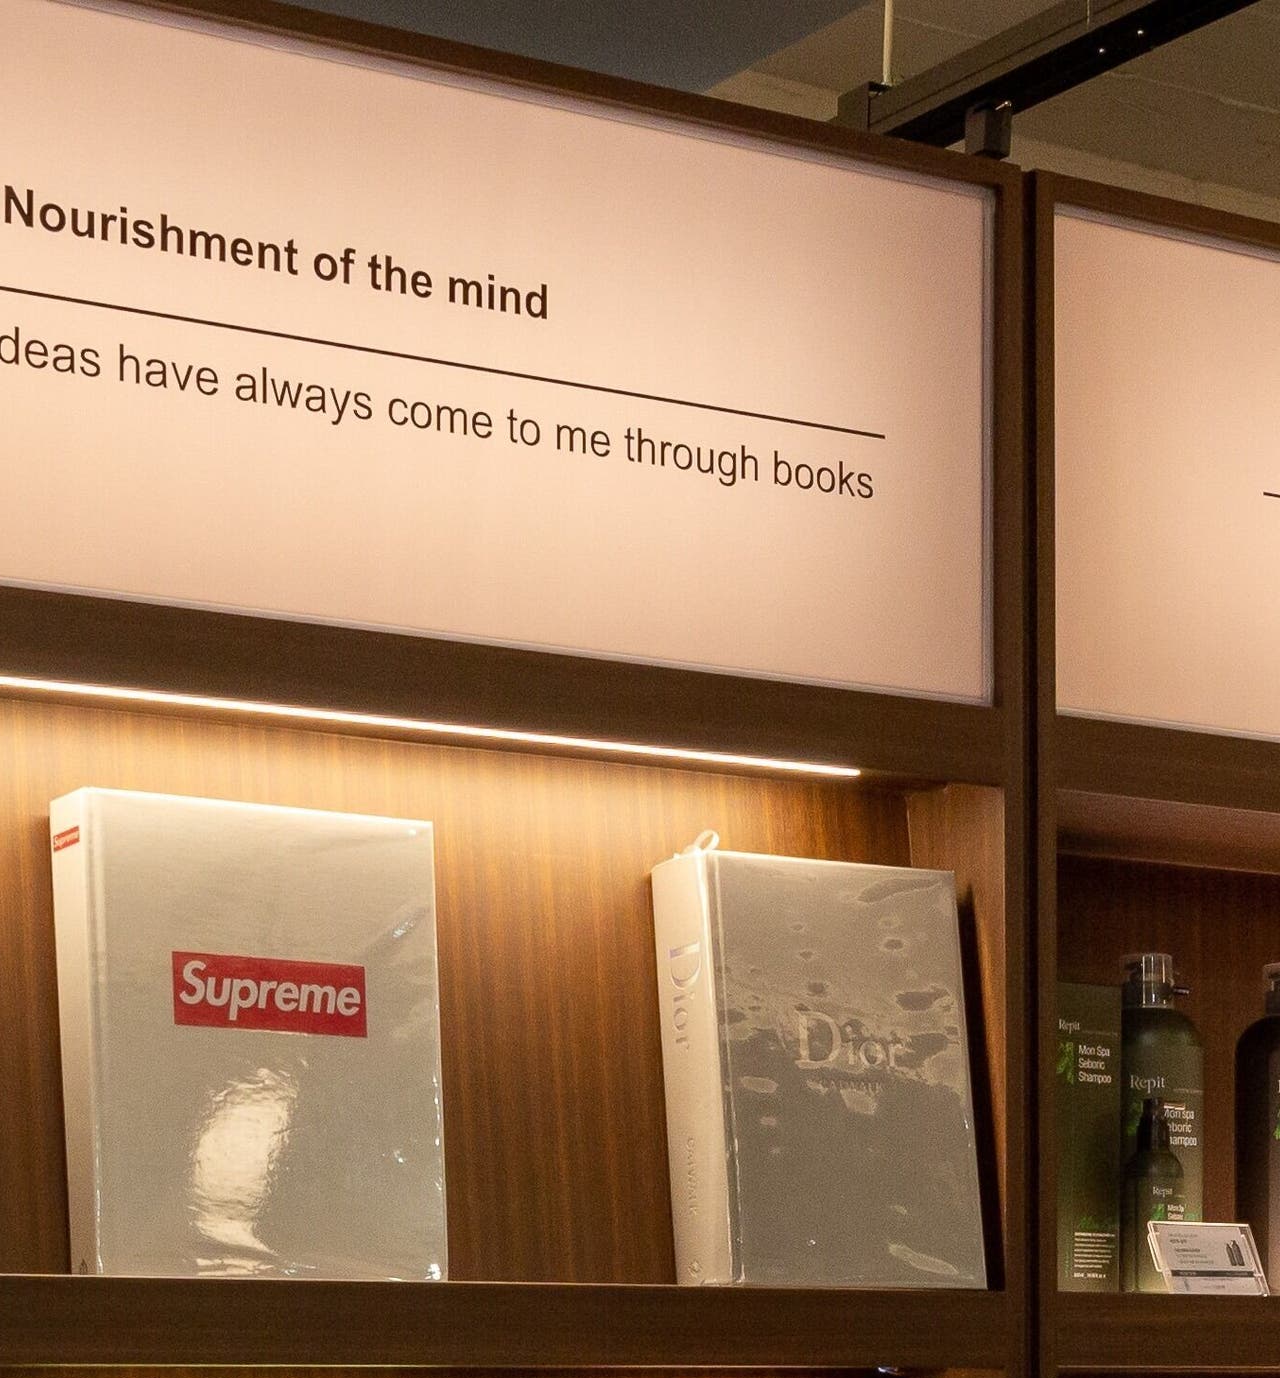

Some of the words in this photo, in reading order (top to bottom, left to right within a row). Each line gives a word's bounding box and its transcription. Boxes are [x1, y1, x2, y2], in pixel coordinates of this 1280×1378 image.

[4, 185, 297, 276] Nourishment
[313, 247, 355, 286] of
[369, 255, 433, 299] the
[448, 283, 549, 320] mind
[119, 342, 220, 397] have
[235, 366, 373, 425] always
[388, 392, 493, 439] come
[508, 408, 541, 446] to
[555, 421, 612, 459] me
[624, 427, 760, 487] through
[773, 450, 875, 500] books
[179, 959, 362, 1021] Supreme
[667, 939, 702, 1057] Dior
[795, 1010, 908, 1070] Dior
[1058, 1019, 1081, 1034] Repit
[1078, 1045, 1096, 1056] Mon
[1096, 1045, 1111, 1057] Spa
[1078, 1071, 1112, 1085] Shampoo
[1129, 1074, 1166, 1094] Repit
